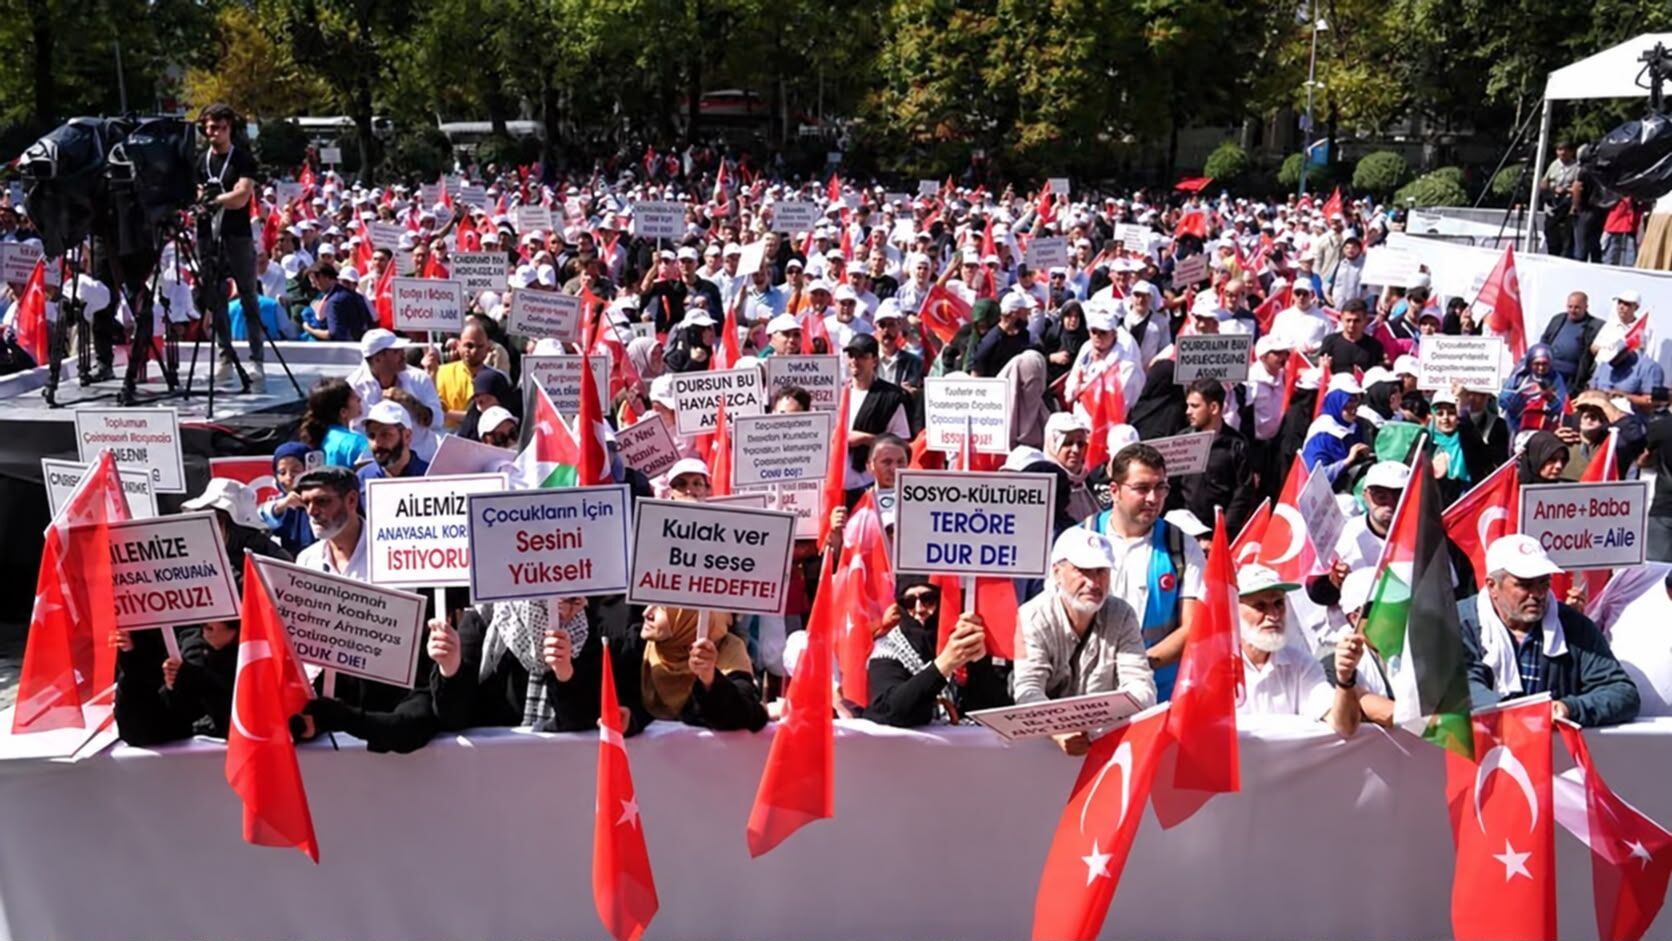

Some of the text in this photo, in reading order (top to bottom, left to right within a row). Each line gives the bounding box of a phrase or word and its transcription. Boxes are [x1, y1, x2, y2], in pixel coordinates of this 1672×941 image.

[676, 376, 732, 394] DURSUN
[737, 374, 754, 388] BU
[395, 491, 466, 518] AİLEMİZ
[903, 484, 1045, 505] SOSYO-KÜLTÜREL
[482, 498, 613, 528] Çocukların İçin
[930, 508, 1016, 535] TERÖRE
[1533, 497, 1631, 520] Anne+Baba
[377, 525, 467, 541] ANAYASAL KOR
[516, 527, 582, 552] Sesini
[662, 518, 770, 546] Kulak ver
[109, 534, 189, 564] İLEMİZE
[388, 545, 470, 571] İSTİYORU
[669, 547, 756, 572] Bu sese
[926, 543, 1018, 566] DUR DE!
[508, 558, 592, 585] Yükselt
[639, 569, 777, 599] AİLE HEDEFTE!
[114, 586, 214, 616] TİYORUZ!
